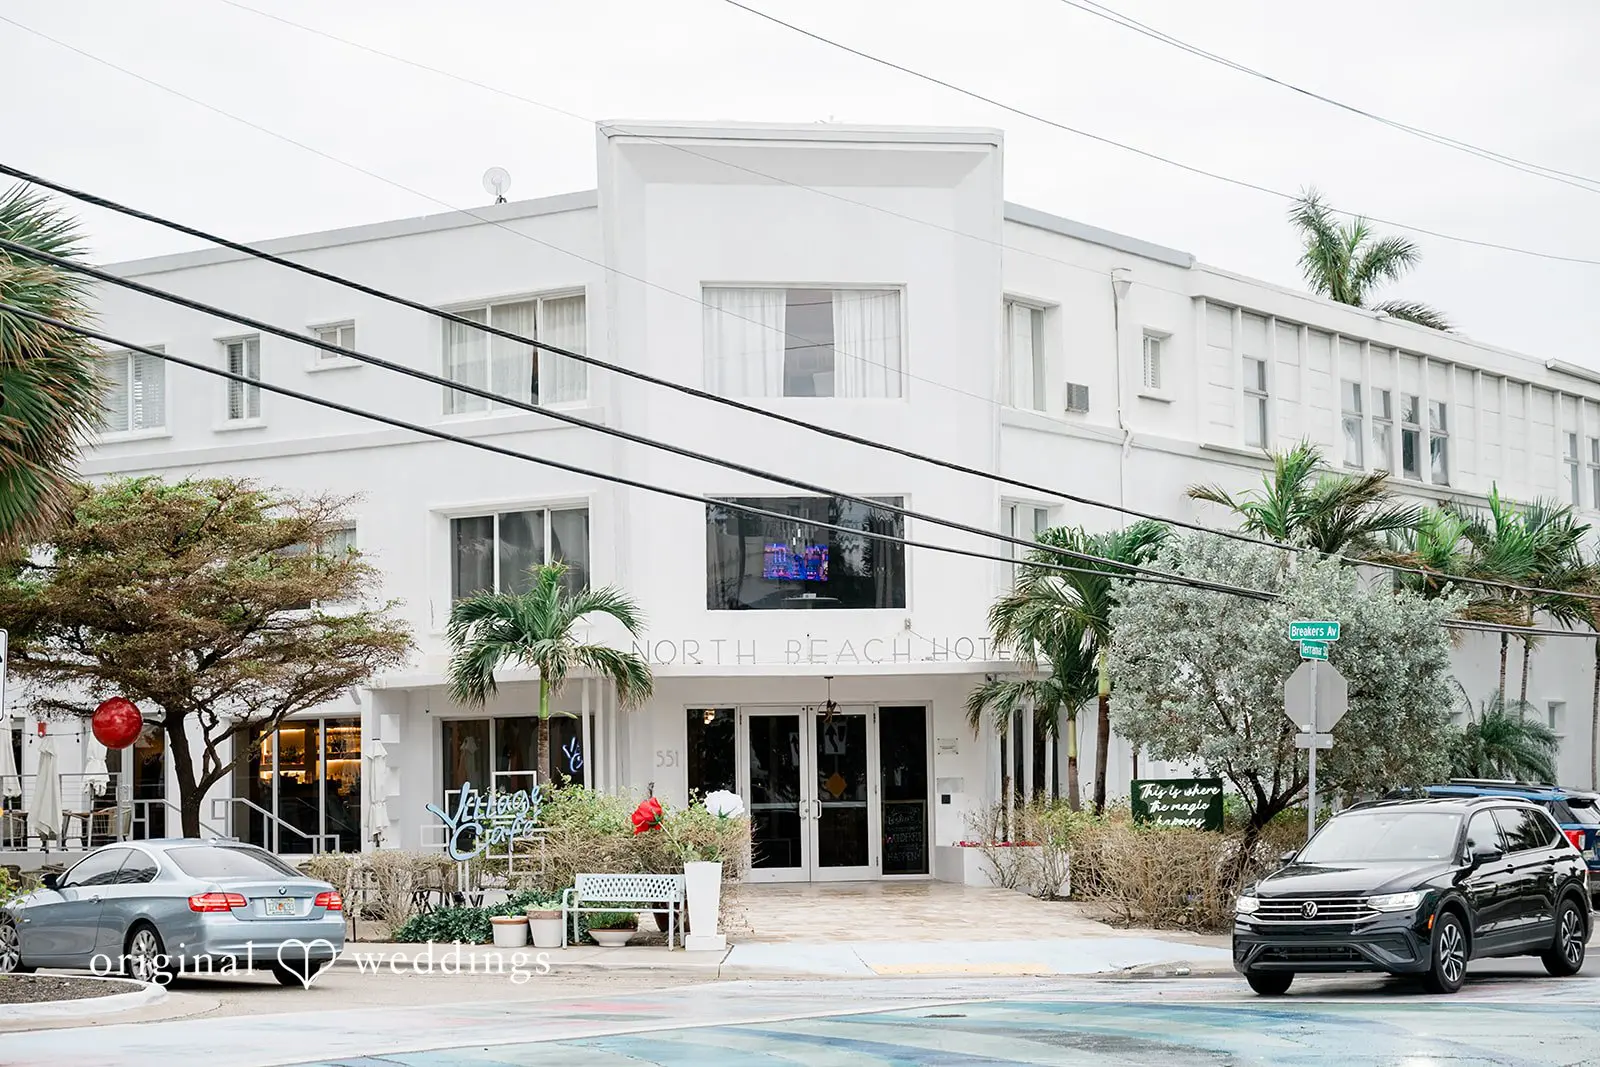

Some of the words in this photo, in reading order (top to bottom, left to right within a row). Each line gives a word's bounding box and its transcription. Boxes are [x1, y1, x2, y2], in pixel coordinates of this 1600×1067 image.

[1291, 625, 1324, 636] Breakers
[1327, 625, 1336, 636] Av
[632, 639, 756, 664] NORTH
[785, 639, 910, 664] BEACH
[656, 750, 679, 768] 551
[1140, 783, 1167, 799] This
[1184, 783, 1220, 797] where
[425, 781, 542, 830] Village
[1149, 800, 1169, 813] the
[1171, 799, 1209, 815] magic
